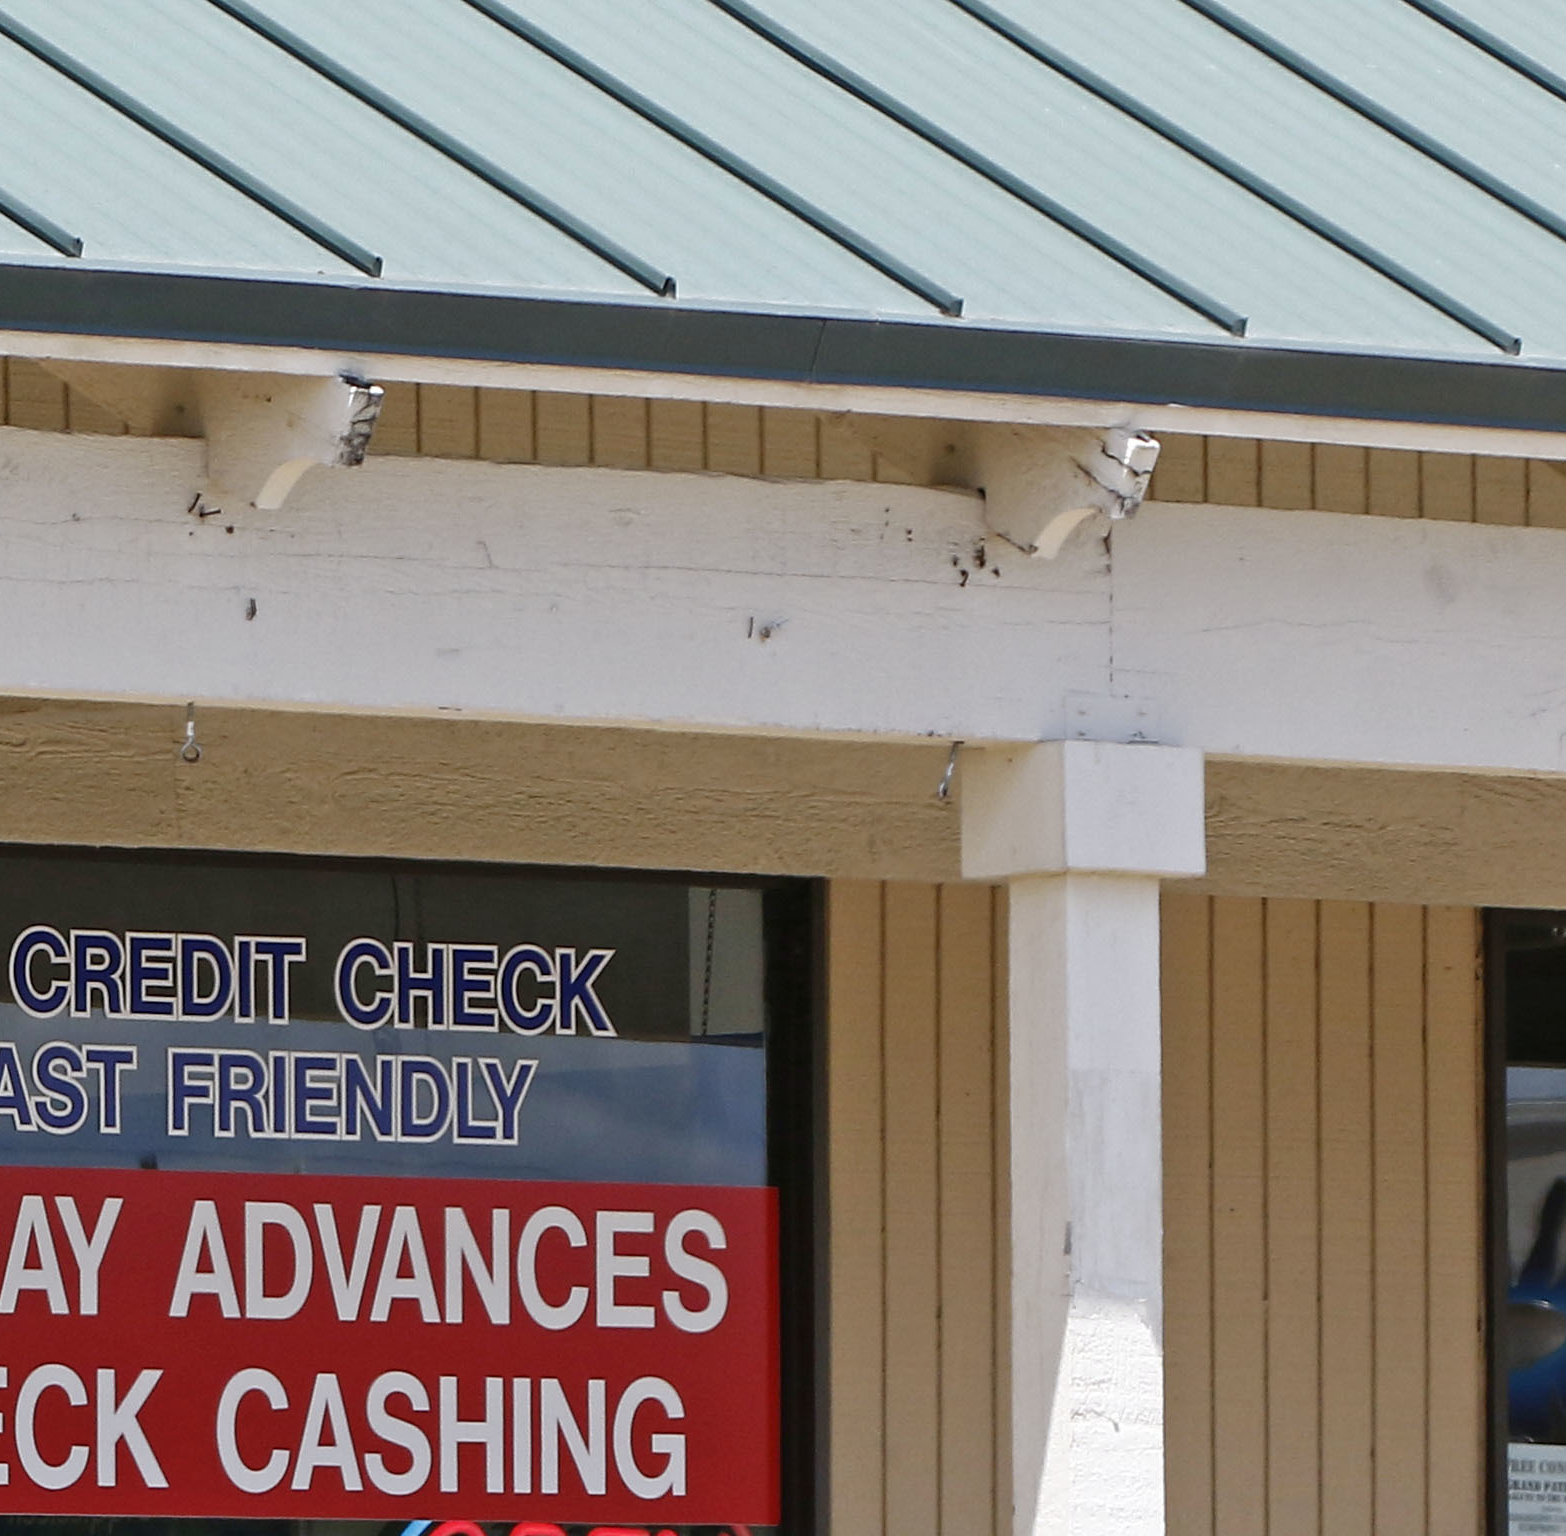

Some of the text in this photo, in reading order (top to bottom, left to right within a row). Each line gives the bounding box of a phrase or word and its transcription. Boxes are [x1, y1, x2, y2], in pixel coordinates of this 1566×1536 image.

[9, 925, 307, 1026] CREDIT
[334, 937, 617, 1038] CHECK
[166, 1046, 539, 1146] FRIENDLY
[169, 1199, 729, 1334] ADVANCES
[216, 1367, 687, 1500] CASHING
